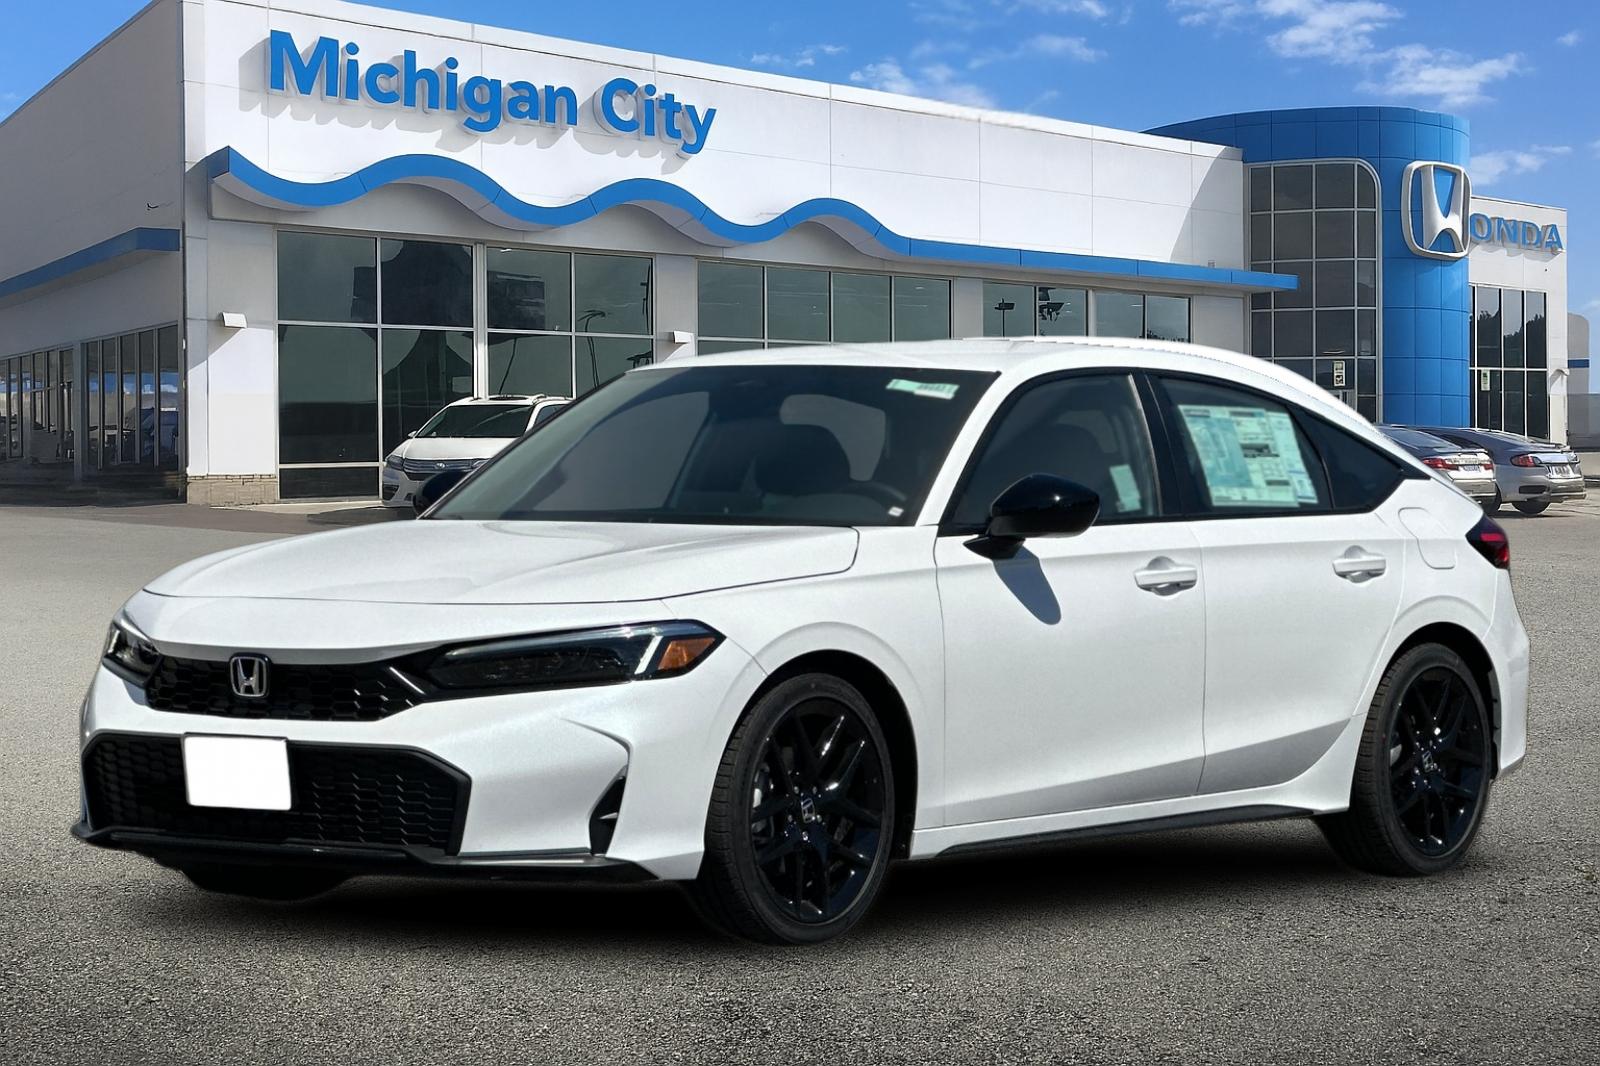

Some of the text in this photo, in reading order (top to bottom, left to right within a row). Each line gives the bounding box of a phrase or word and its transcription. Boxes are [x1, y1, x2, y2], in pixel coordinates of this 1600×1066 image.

[269, 29, 717, 155] Michigan City
[1469, 212, 1564, 251] ONDA
